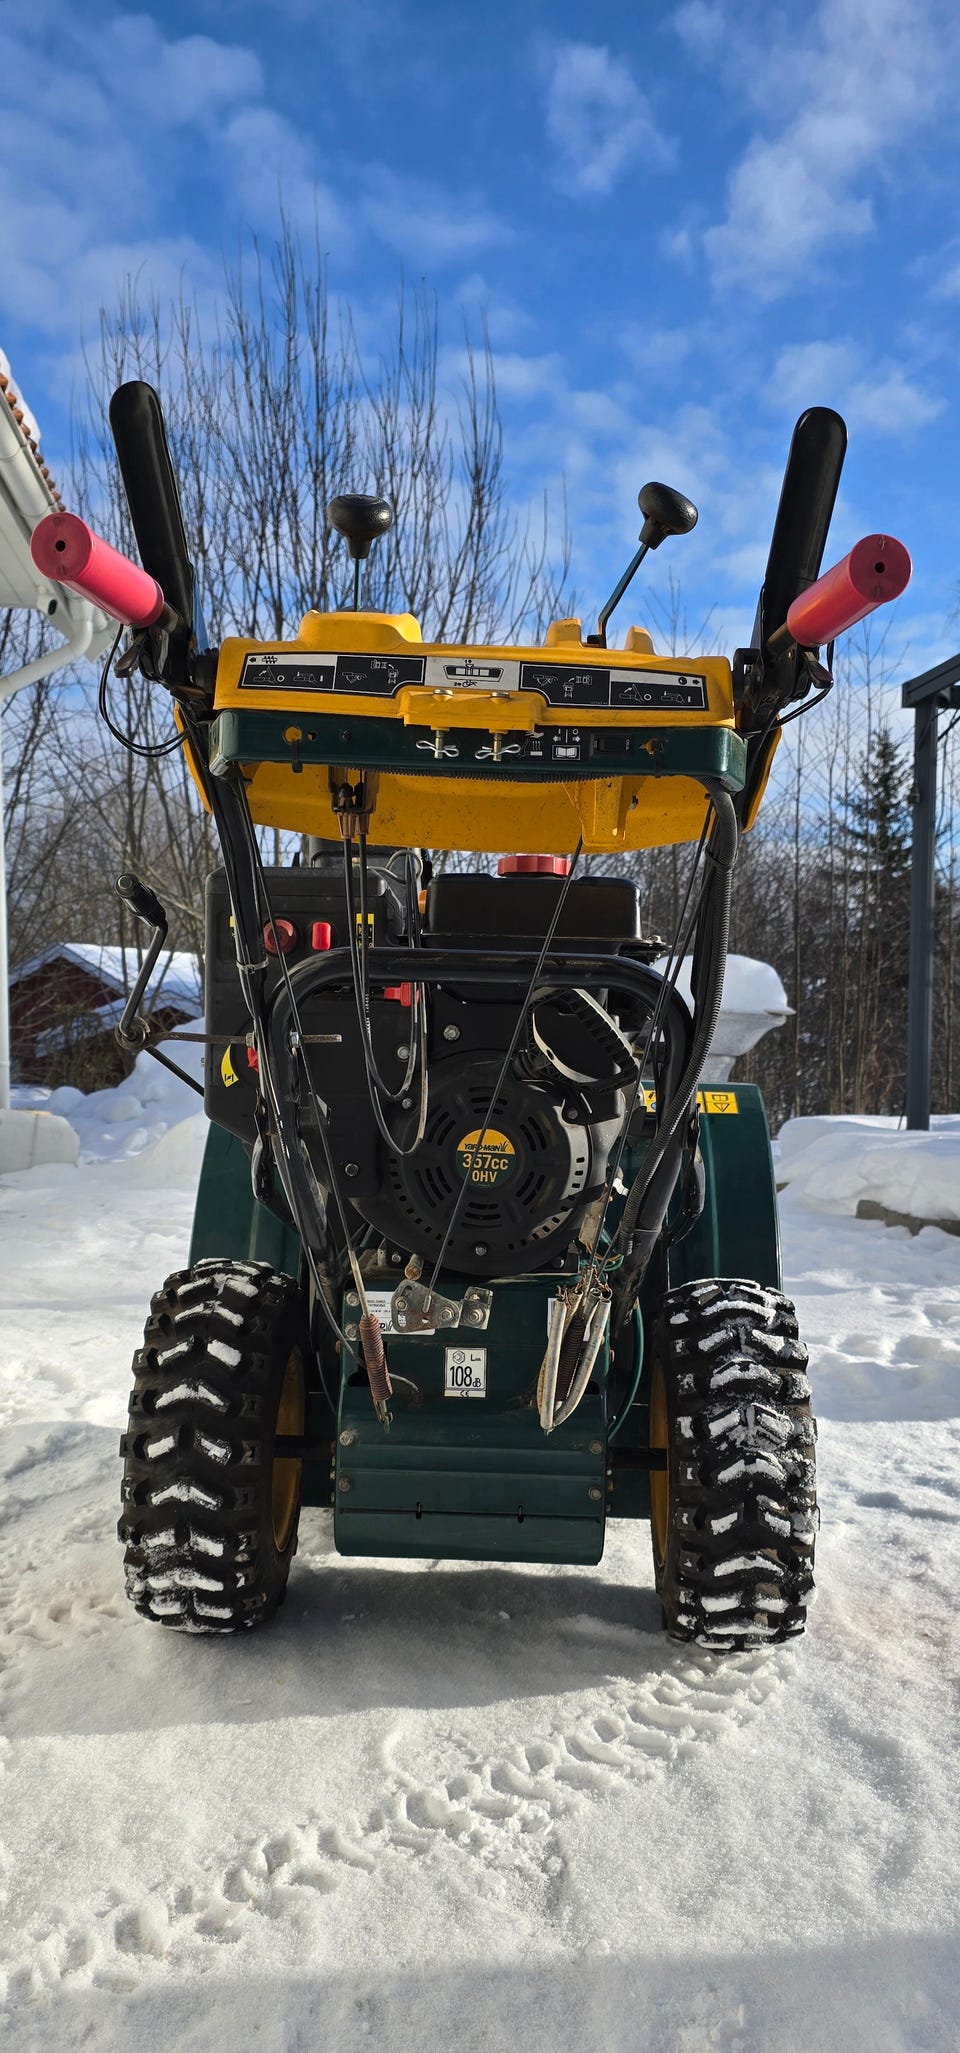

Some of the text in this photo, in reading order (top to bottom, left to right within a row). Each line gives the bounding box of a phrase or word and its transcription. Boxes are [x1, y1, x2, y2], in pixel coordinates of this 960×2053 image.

[462, 1153, 509, 1170] 357cc
[472, 1170, 498, 1183] OHV
[450, 1365, 482, 1388] 108 dB
